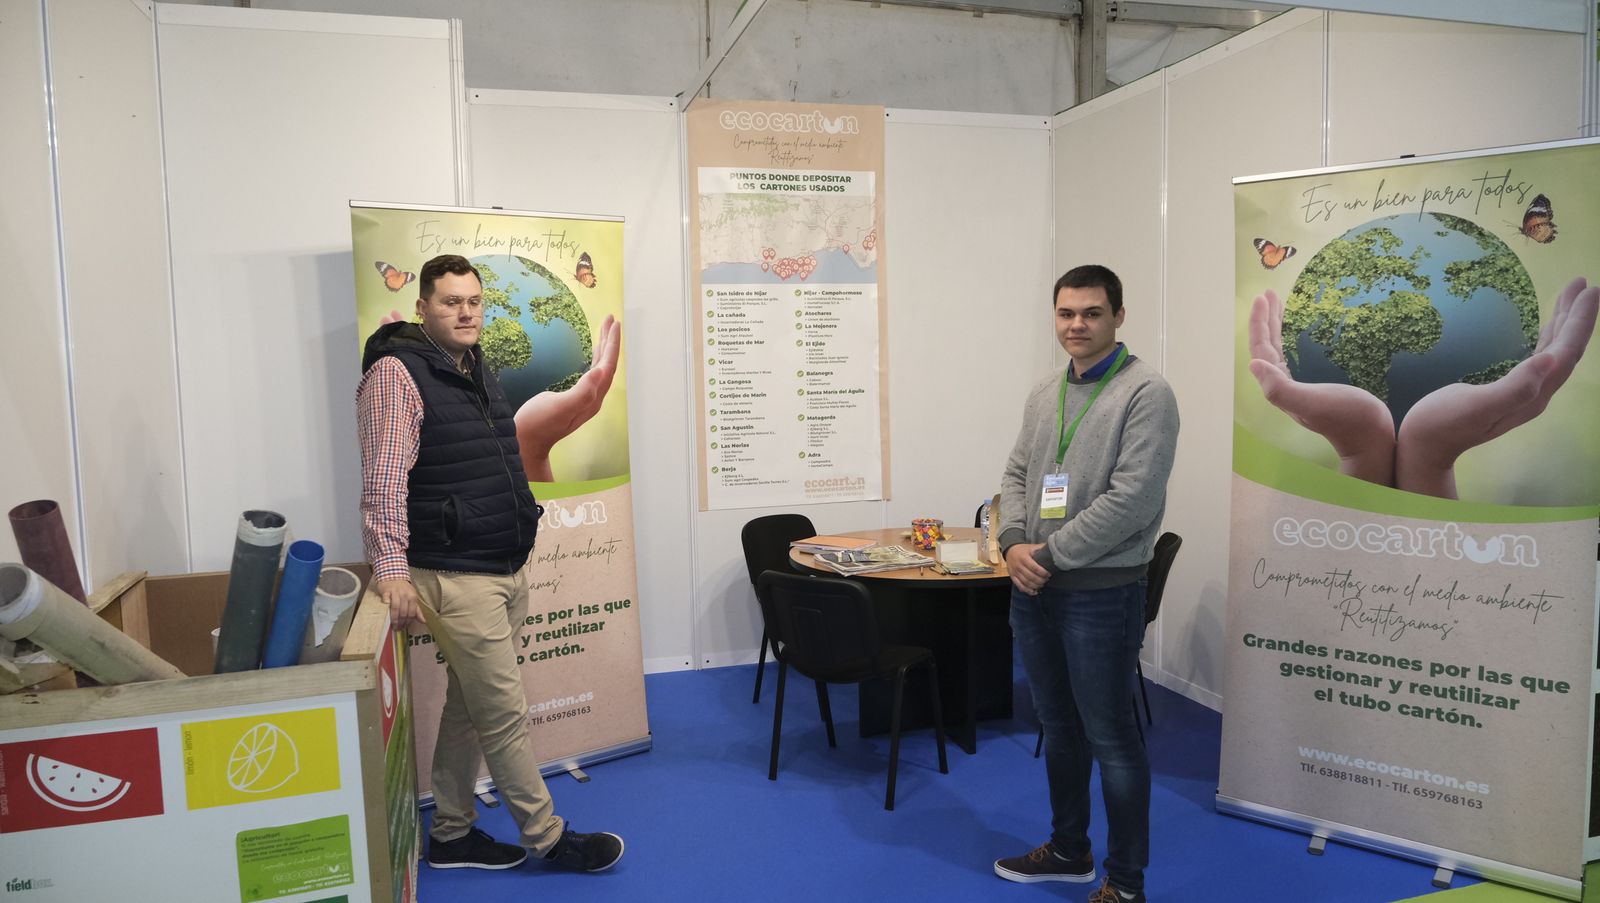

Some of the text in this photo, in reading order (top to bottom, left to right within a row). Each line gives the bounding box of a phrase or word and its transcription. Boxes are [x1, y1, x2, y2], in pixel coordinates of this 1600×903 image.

[733, 134, 780, 150] Comprometidos
[730, 173, 852, 183] PUNTOS DONDE DEPOSITAR
[760, 183, 807, 192] CARTONES
[809, 184, 845, 193] USADOS
[1302, 183, 1338, 224] Es
[1344, 199, 1368, 211] un
[1373, 178, 1416, 213] bien
[1419, 184, 1473, 223] para
[416, 220, 447, 253] Es
[451, 237, 470, 247] un
[473, 223, 505, 249] bien
[509, 235, 543, 262] para
[538, 543, 569, 569] medio
[572, 537, 622, 564] ambiente
[1253, 557, 1565, 625] Comprometidos con el medio ambiente
[548, 607, 574, 626] por
[578, 604, 600, 617] las
[603, 598, 632, 615] que
[521, 634, 532, 648] y
[535, 619, 606, 643] reutilizar
[529, 643, 585, 663] cartón.
[1242, 633, 1571, 695] Grandes razones por las que
[1279, 660, 1520, 711] gestionar y reutilizar
[529, 690, 594, 714] carton.es
[532, 716, 545, 726] Tlf.
[546, 705, 591, 723] 659768163
[1314, 687, 1483, 729] el tubo cartón.
[1297, 745, 1490, 795] www.ecocarton.es
[1300, 762, 1318, 775] Tlf.
[1319, 767, 1383, 789] 638818811
[1392, 781, 1411, 795] Tlf.
[1413, 786, 1483, 810] 659768163
